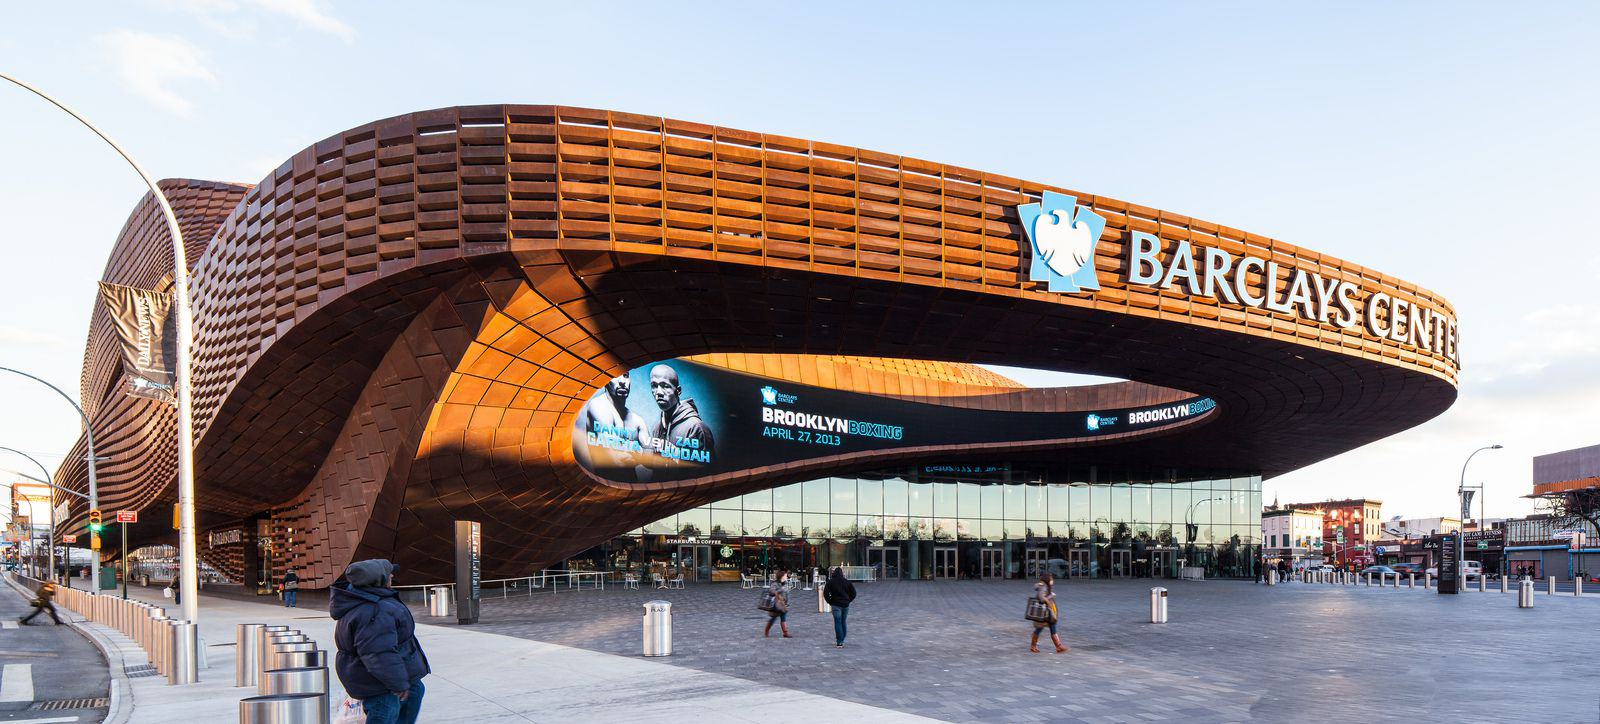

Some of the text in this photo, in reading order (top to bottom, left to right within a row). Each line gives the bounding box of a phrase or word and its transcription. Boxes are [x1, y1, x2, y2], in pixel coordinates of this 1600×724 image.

[1128, 229, 1357, 328] BARCLAYS
[137, 296, 151, 367] DAILY NEWS
[593, 420, 638, 440] DANNY
[762, 426, 841, 446] APRIL 27, 2013
[587, 431, 642, 453] GARCIA
[675, 435, 700, 449] ZAB
